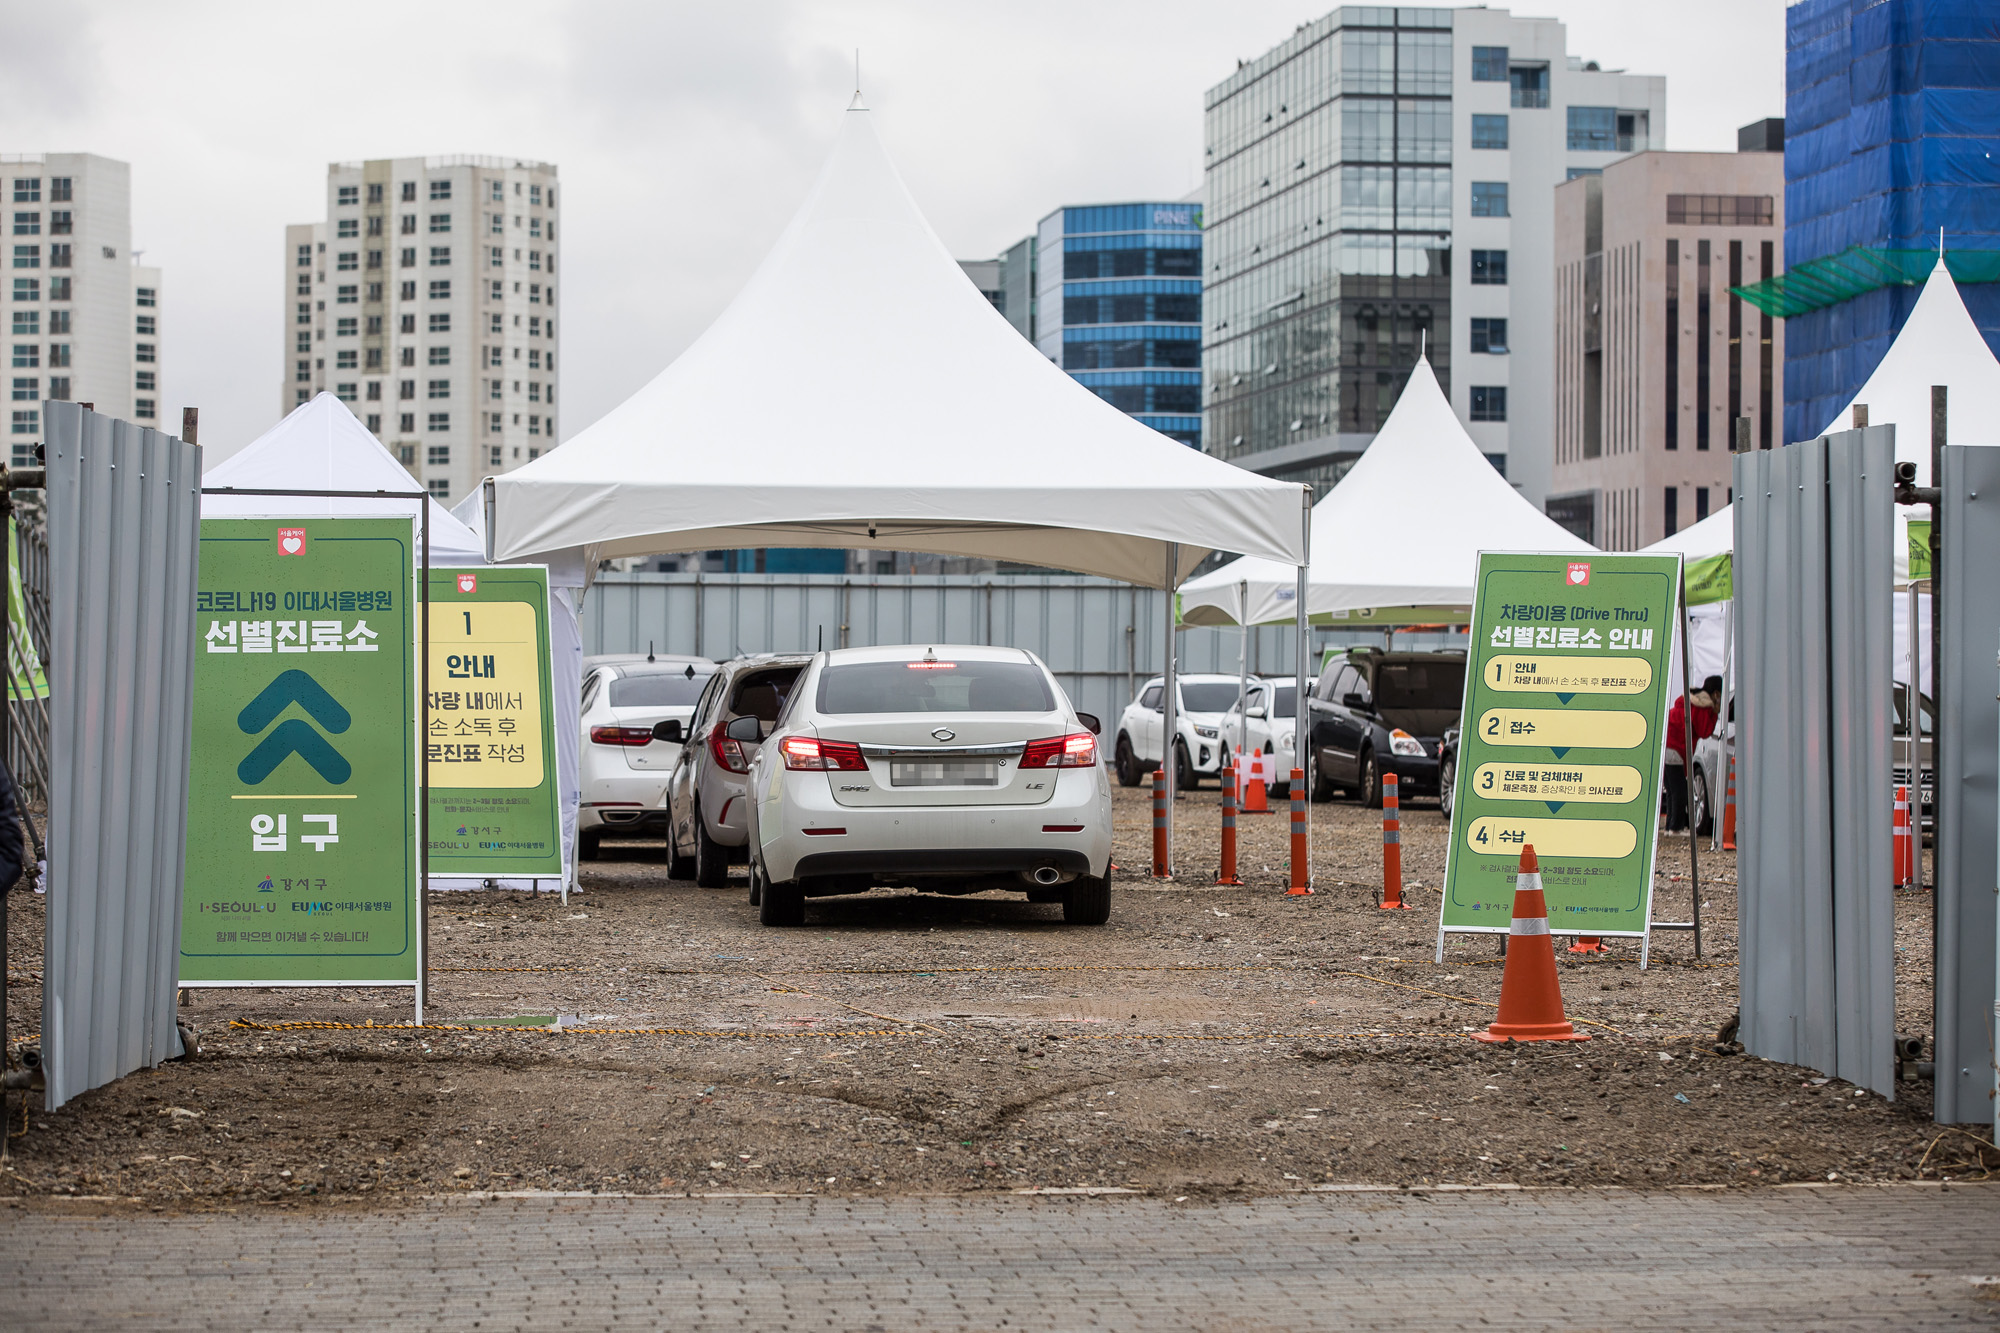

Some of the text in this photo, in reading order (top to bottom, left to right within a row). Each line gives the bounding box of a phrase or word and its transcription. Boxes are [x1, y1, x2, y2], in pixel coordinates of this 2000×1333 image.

[1154, 210, 1189, 224] PINE
[197, 590, 392, 612] 코로나19 이대서울병원
[1500, 604, 1649, 622] 차량이용 (Drive Thru)
[463, 611, 472, 636] 1
[204, 620, 379, 654] 선별진료소
[1490, 625, 1654, 651] 선별진료소 안내
[446, 654, 496, 680] 안내
[1495, 664, 1502, 682] 1
[1515, 662, 1537, 674] 안내
[1514, 676, 1647, 688] 차량 내에서 손 소독 후 문진표 작성
[466, 692, 522, 710] 내에서
[430, 718, 516, 736] 손 소독 후
[1487, 716, 1500, 736] 2
[1510, 721, 1536, 735] 접수
[488, 744, 525, 763] 작성
[1481, 770, 1494, 790] 3
[1504, 770, 1583, 783] 진료 및 검체채취
[1541, 785, 1576, 795] 증상확인
[1578, 786, 1587, 795] 등
[1588, 786, 1623, 796] 의사진료
[1475, 826, 1489, 845] 4
[1498, 830, 1526, 844] 수납
[1543, 866, 1565, 875] 2~3일
[1566, 867, 1582, 875] 정도
[1572, 877, 1587, 886] 안내
[335, 901, 392, 912] 이대서울병원
[216, 931, 369, 943] 함께 막으면 이겨낼 수 있습니다!
